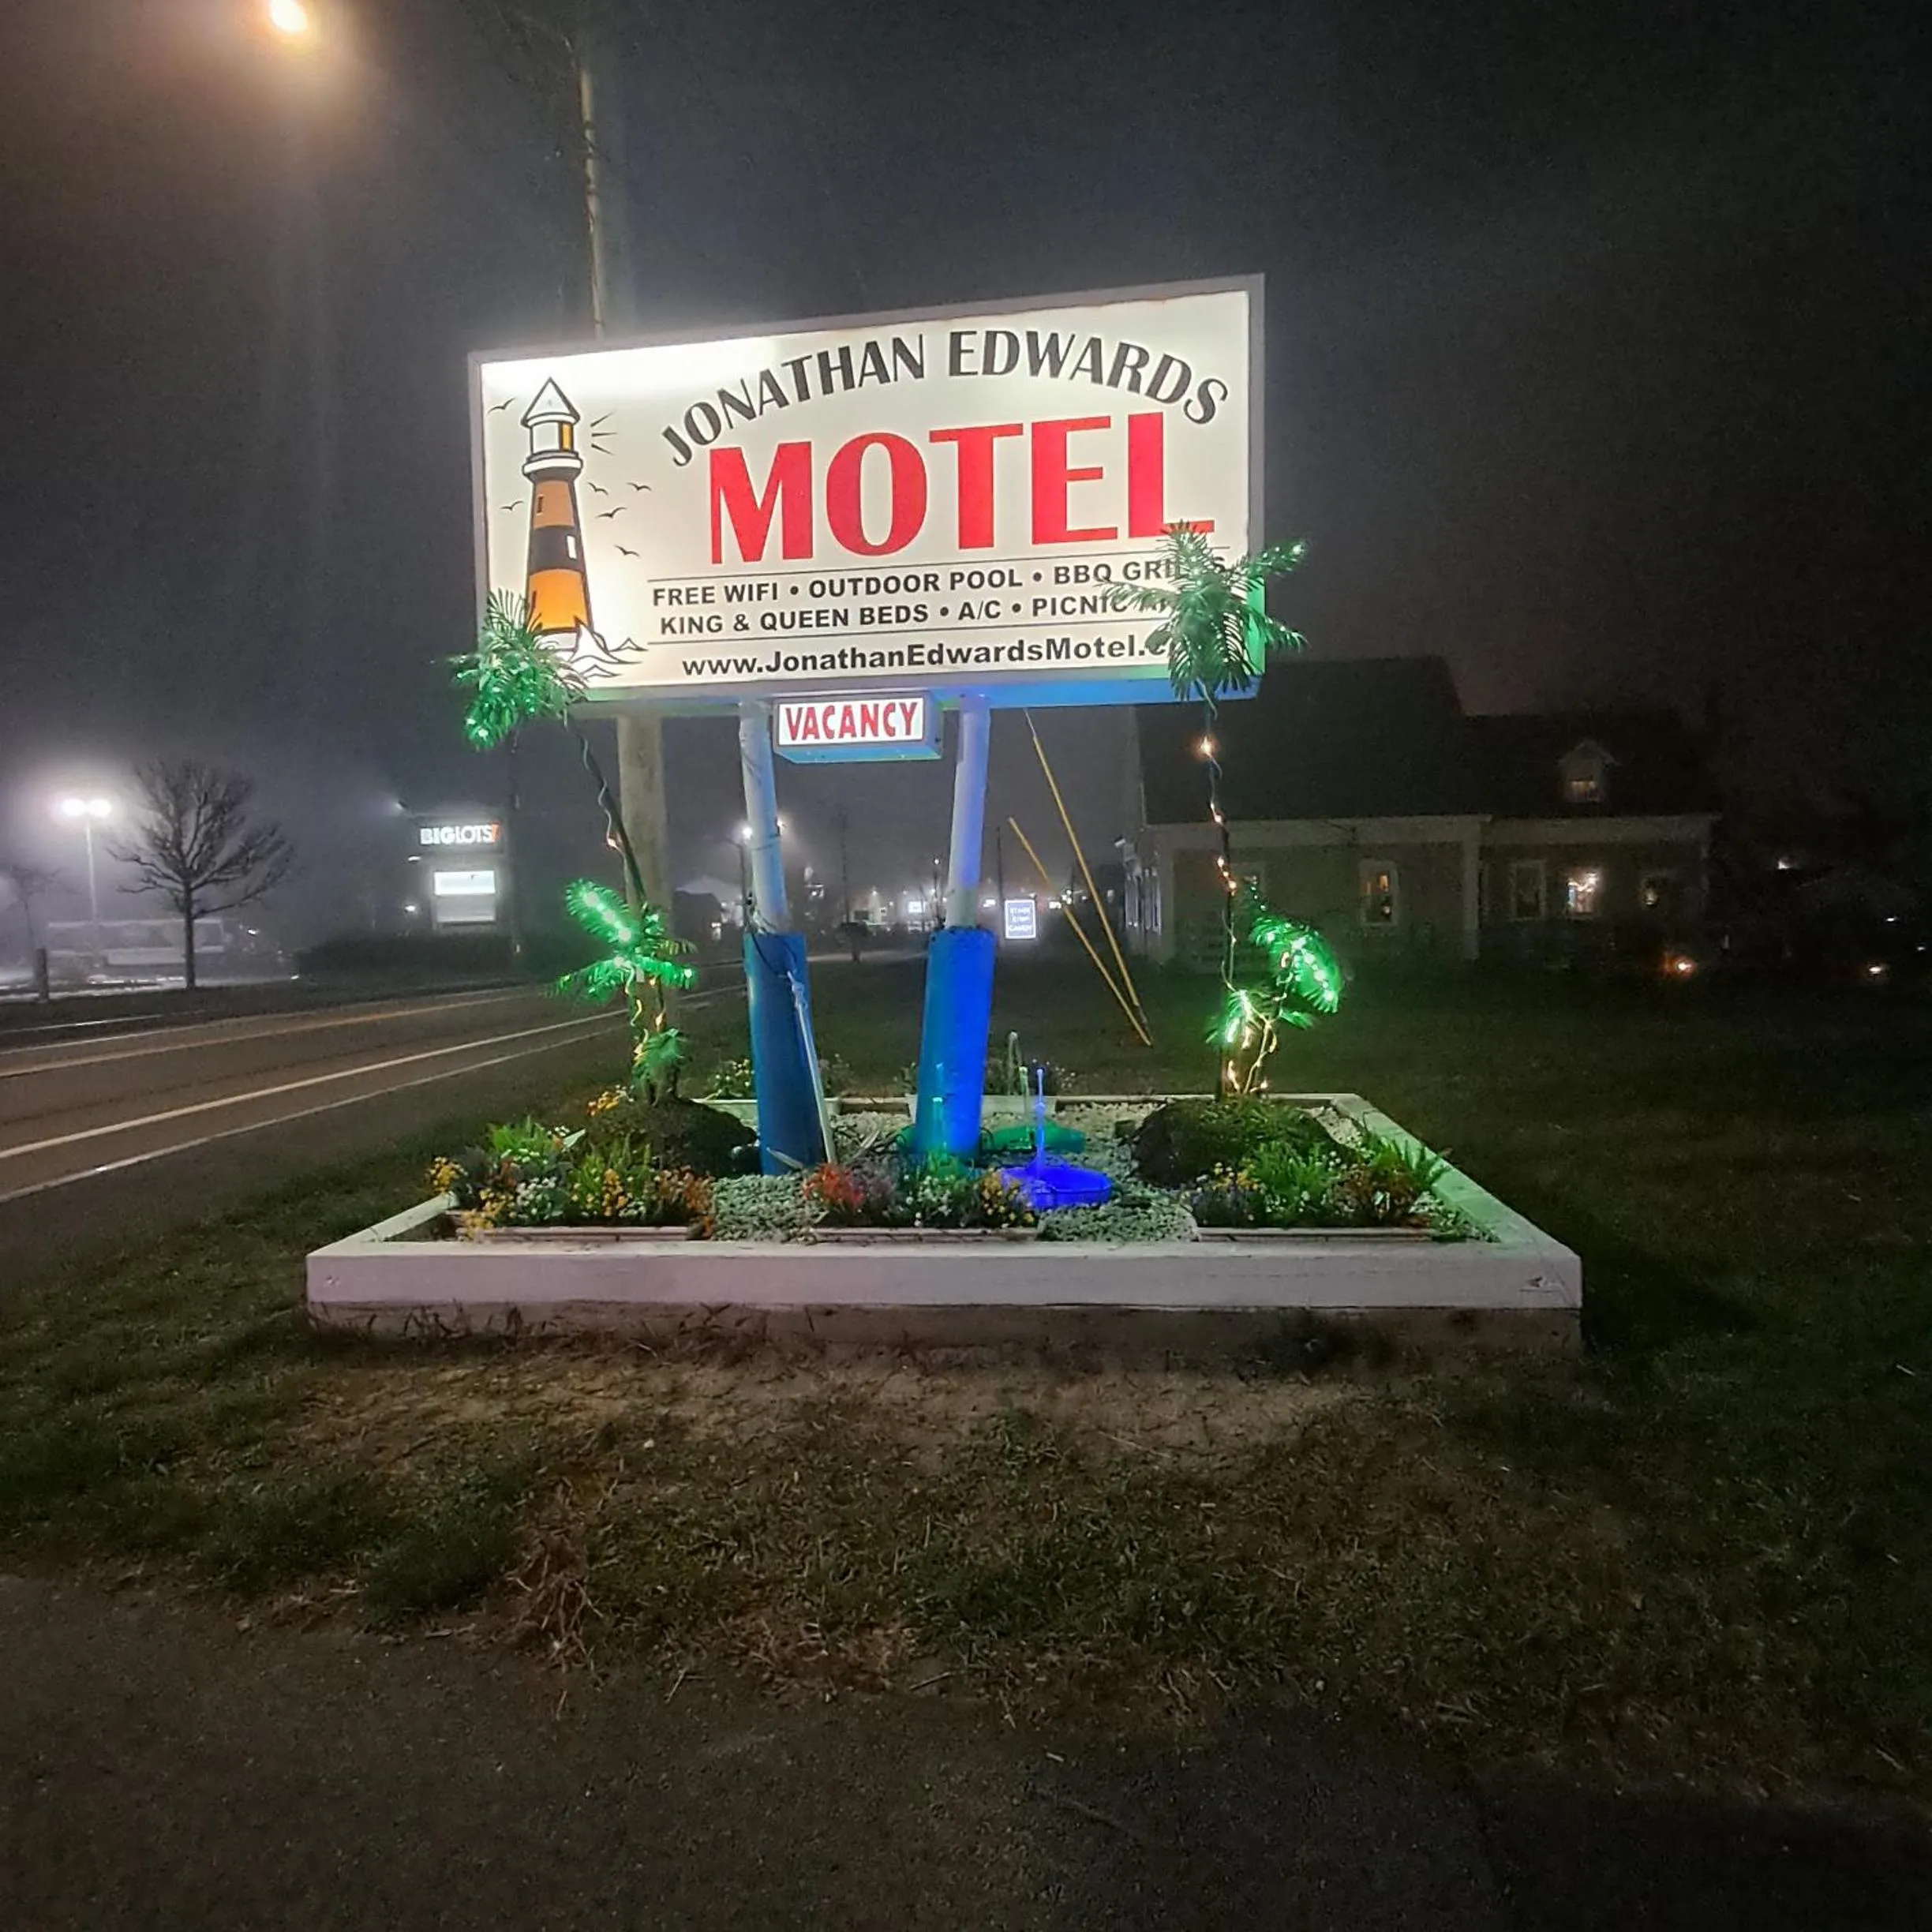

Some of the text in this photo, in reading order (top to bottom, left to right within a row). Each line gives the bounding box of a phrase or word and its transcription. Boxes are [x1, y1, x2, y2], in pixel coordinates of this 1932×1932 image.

[661, 330, 1229, 467] JONATHAN EDWARDS
[710, 412, 1215, 565] MOTEL
[653, 586, 716, 606] FREE
[724, 582, 778, 603] WIFI
[809, 573, 941, 598] OUTDOOR
[949, 568, 1023, 590] POOL
[1054, 564, 1112, 585] BBQ
[661, 615, 723, 635] KING
[733, 613, 750, 632] &
[760, 608, 848, 631] QUEEN
[859, 604, 928, 626] BEDS
[957, 600, 1002, 620] A/C
[785, 702, 918, 741] VACANCY
